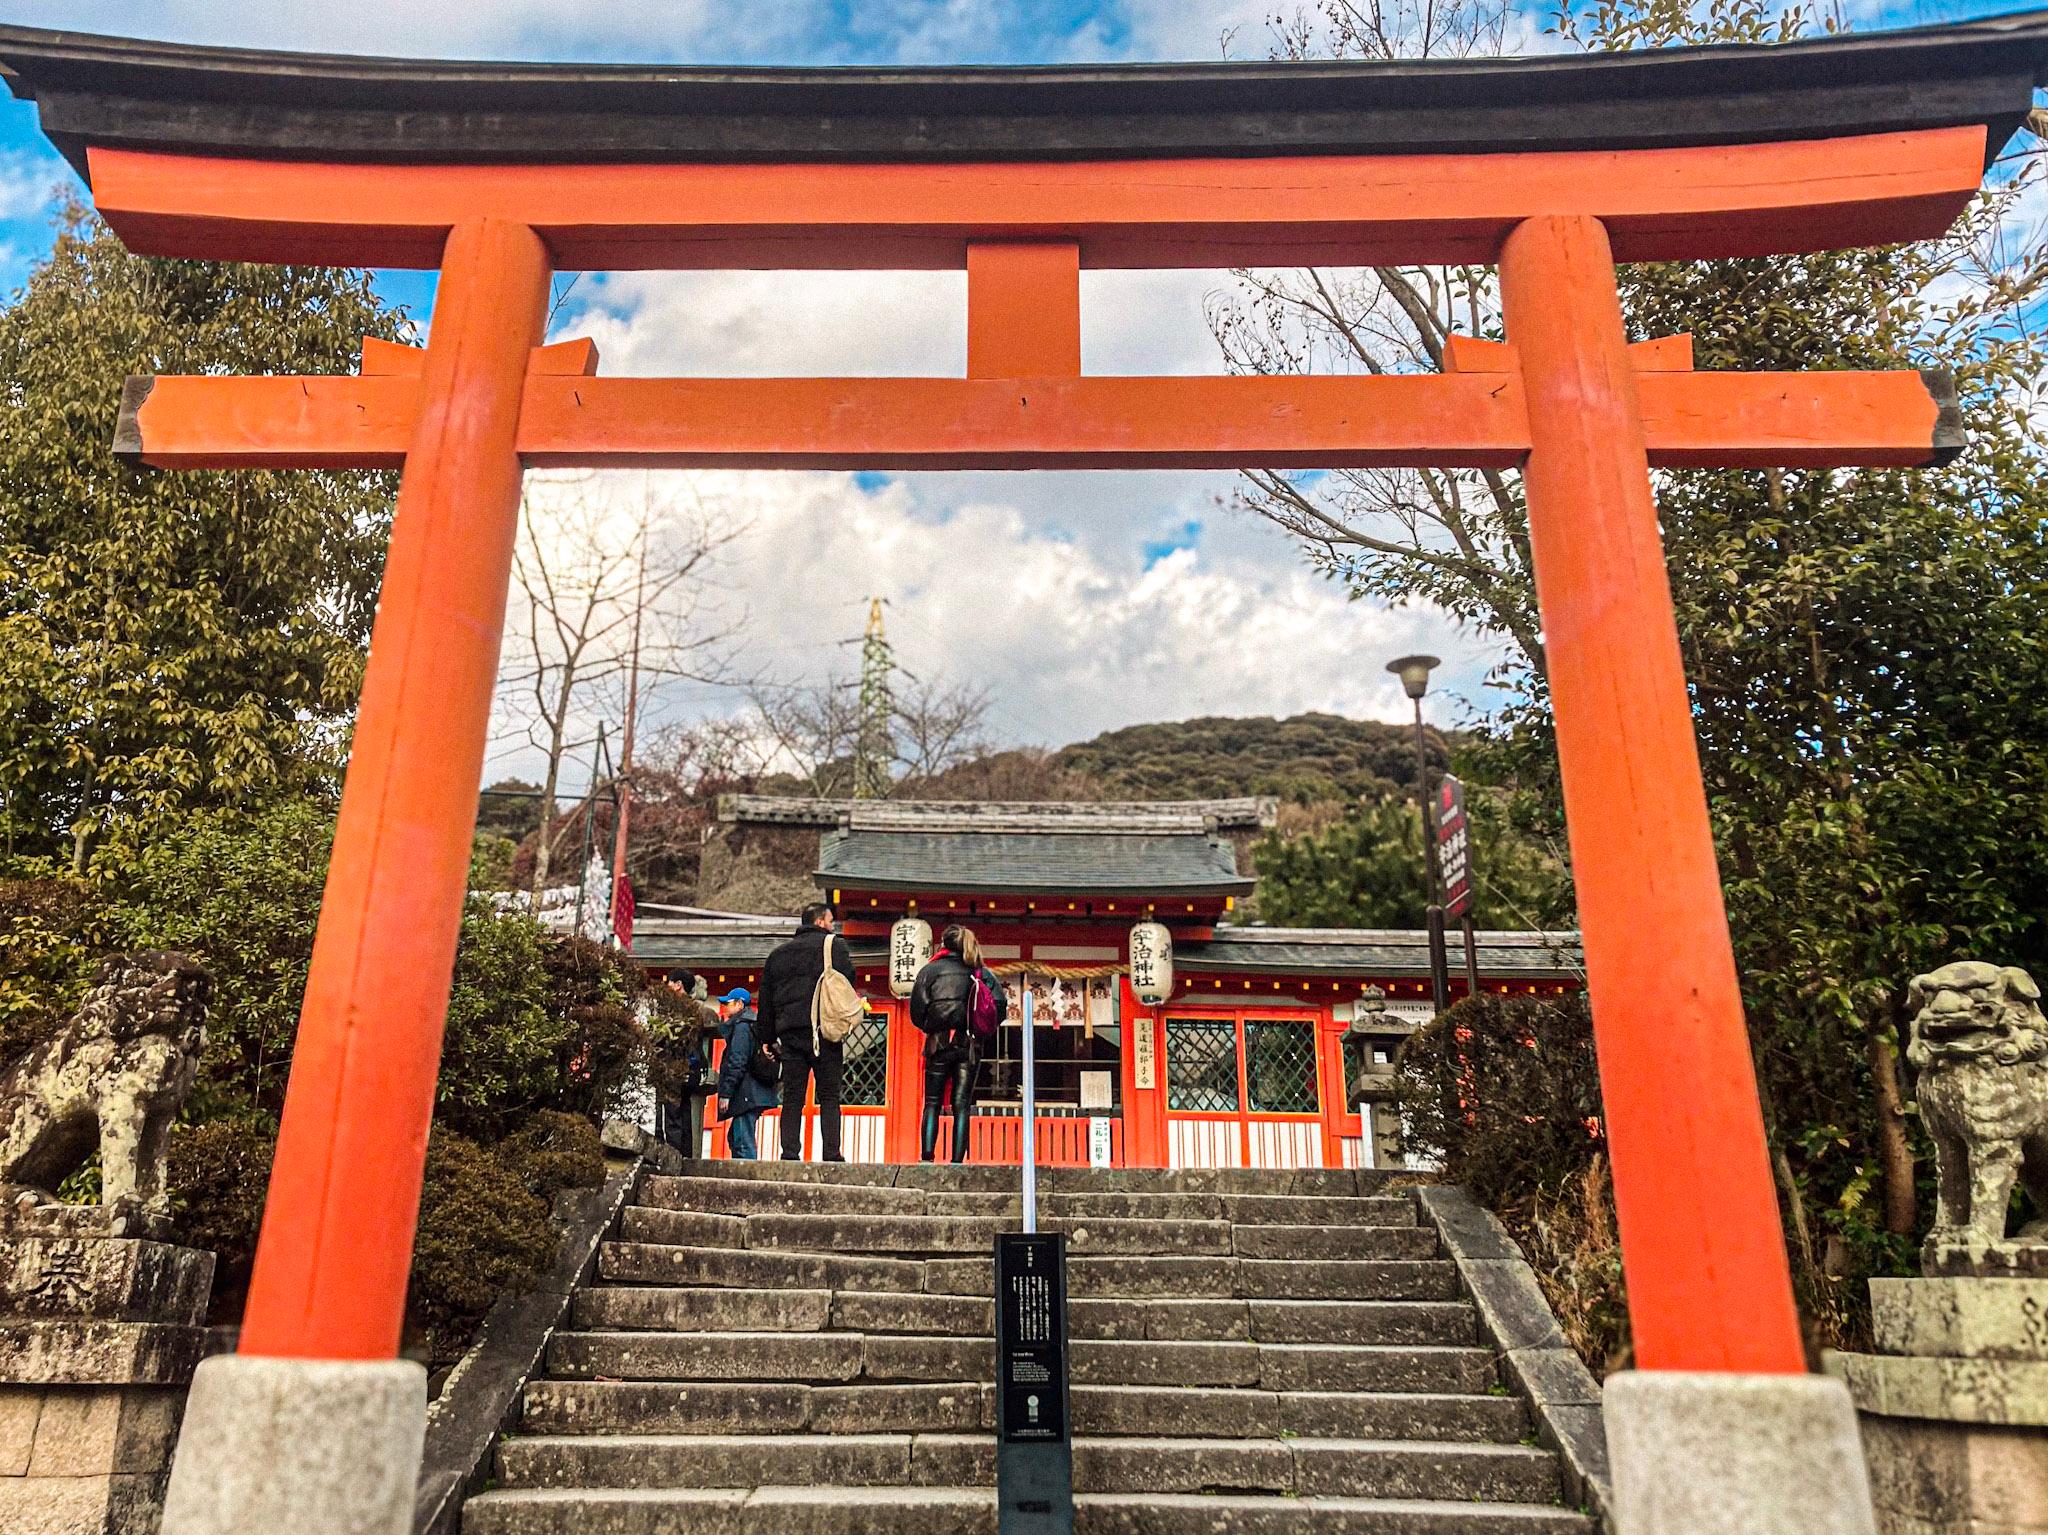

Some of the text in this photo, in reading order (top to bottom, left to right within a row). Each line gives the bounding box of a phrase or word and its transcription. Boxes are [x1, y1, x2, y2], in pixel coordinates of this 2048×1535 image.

[894, 924, 916, 983] 宇治神社
[1132, 929, 1155, 987] 宇治神社
